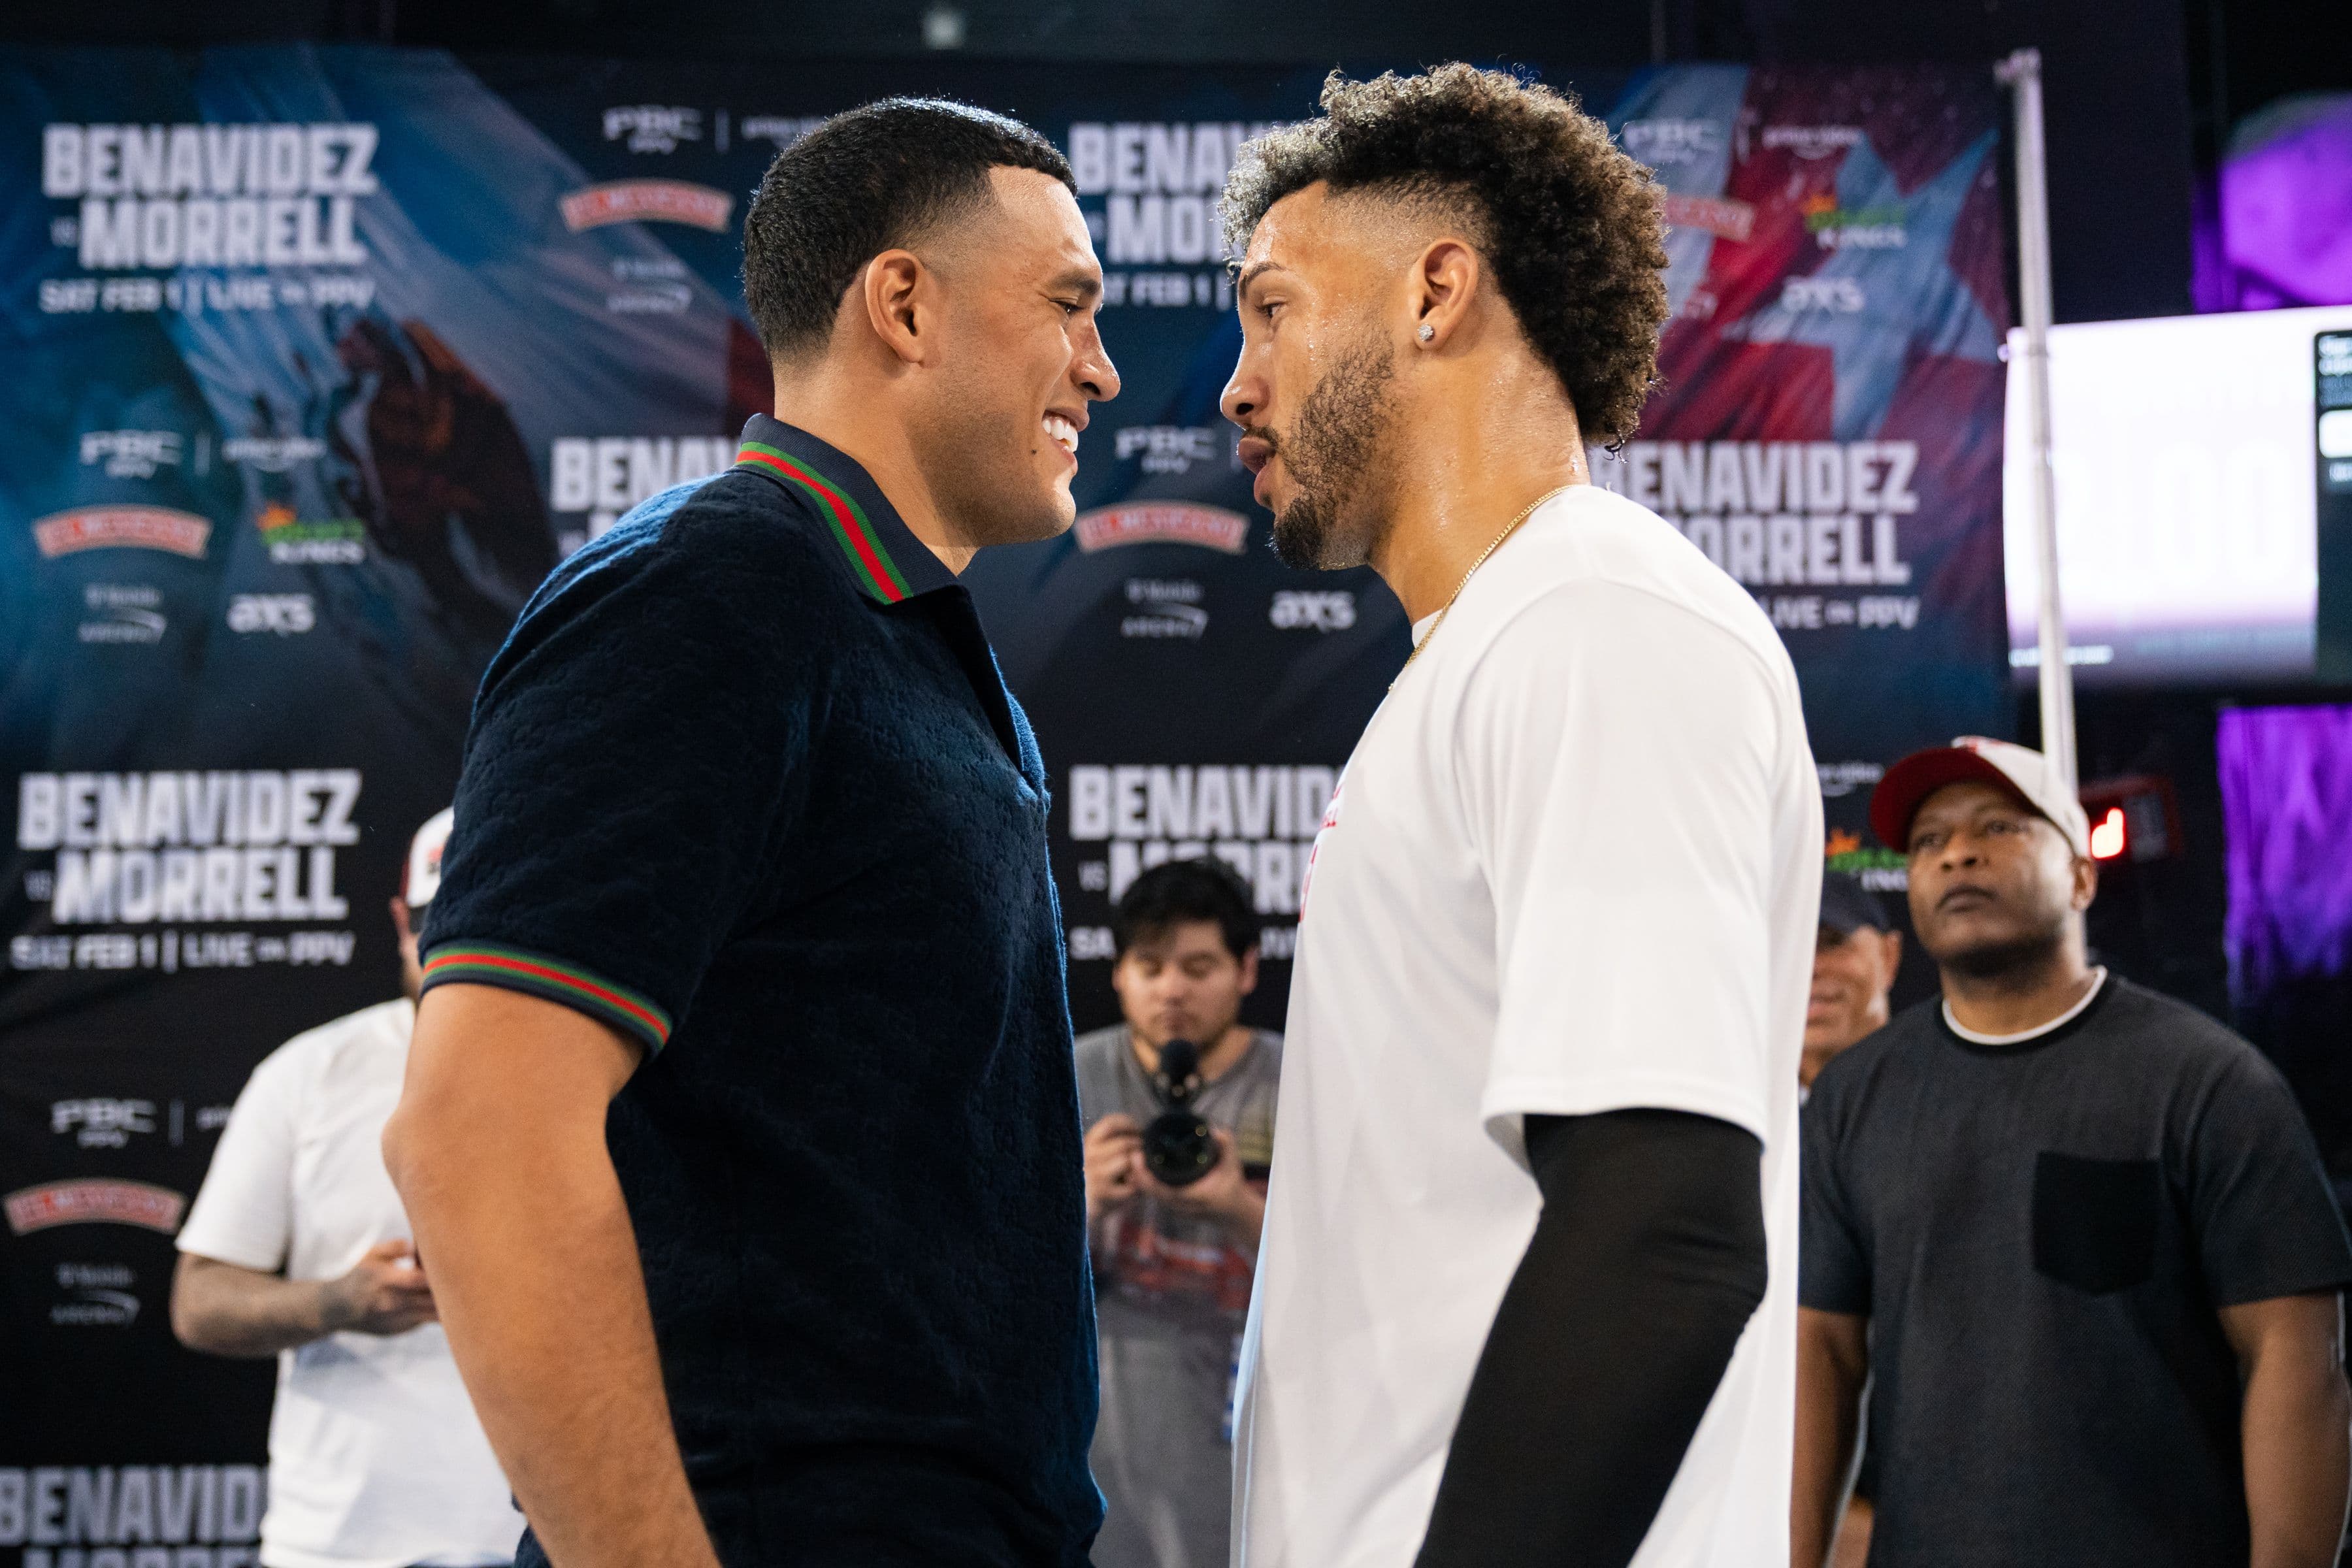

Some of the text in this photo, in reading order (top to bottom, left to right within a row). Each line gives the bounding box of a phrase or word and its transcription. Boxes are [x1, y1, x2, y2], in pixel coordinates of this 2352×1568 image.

[43, 122, 378, 196] BENAVIDEZ
[79, 197, 367, 268] MORRELL
[40, 279, 97, 312] SAT
[102, 279, 161, 312] FEB
[1679, 515, 1909, 585] ORRELL
[18, 769, 361, 849] BENAVIDEZ
[53, 848, 350, 923] MORRELL
[11, 934, 71, 969] SAT
[75, 934, 137, 968] FEB
